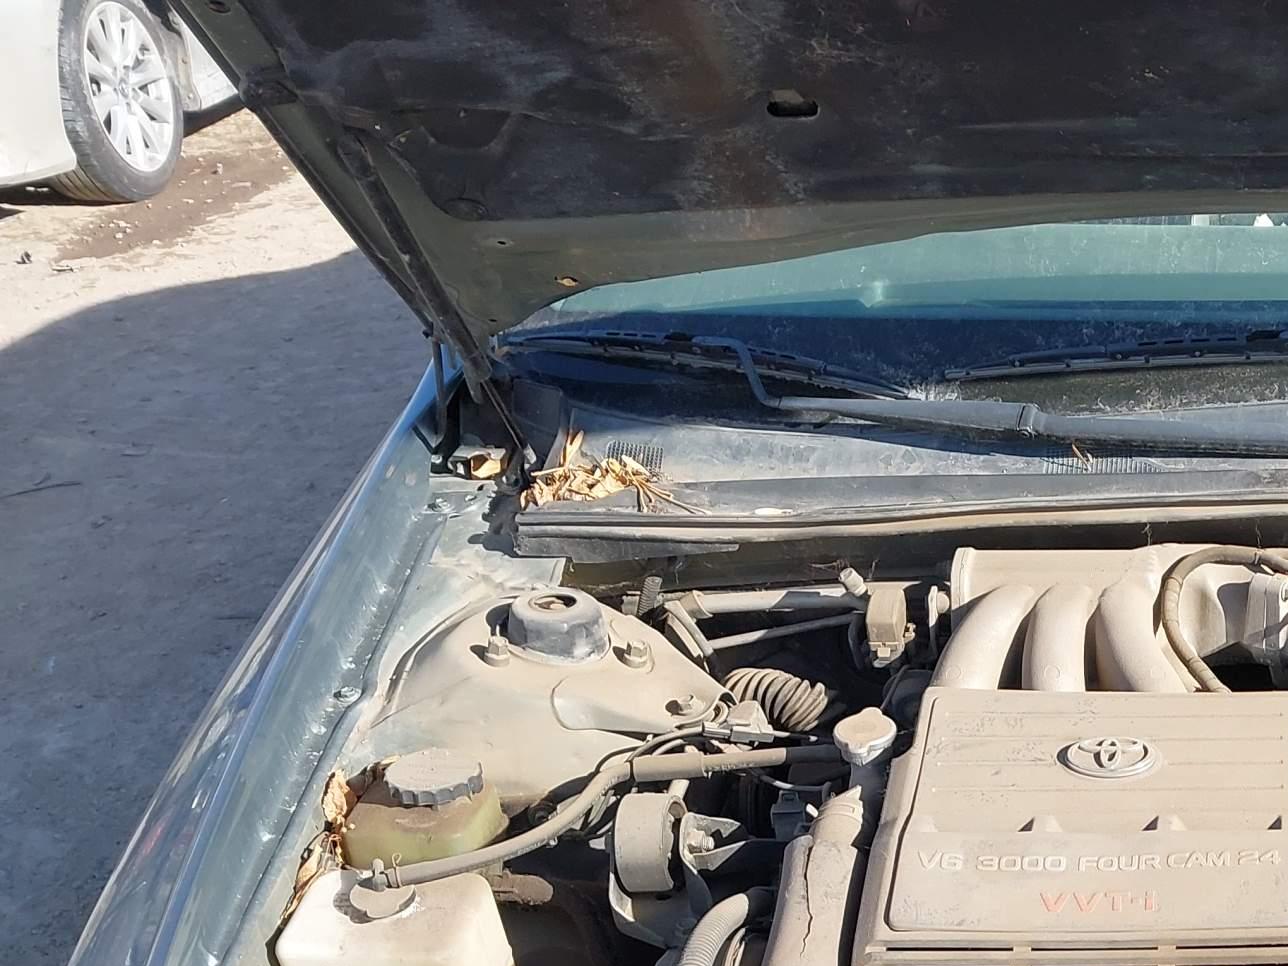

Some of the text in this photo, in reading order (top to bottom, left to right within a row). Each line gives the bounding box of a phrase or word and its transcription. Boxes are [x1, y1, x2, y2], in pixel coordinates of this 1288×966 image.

[917, 848, 1281, 872] V6 3000 FOUR CAM 24
